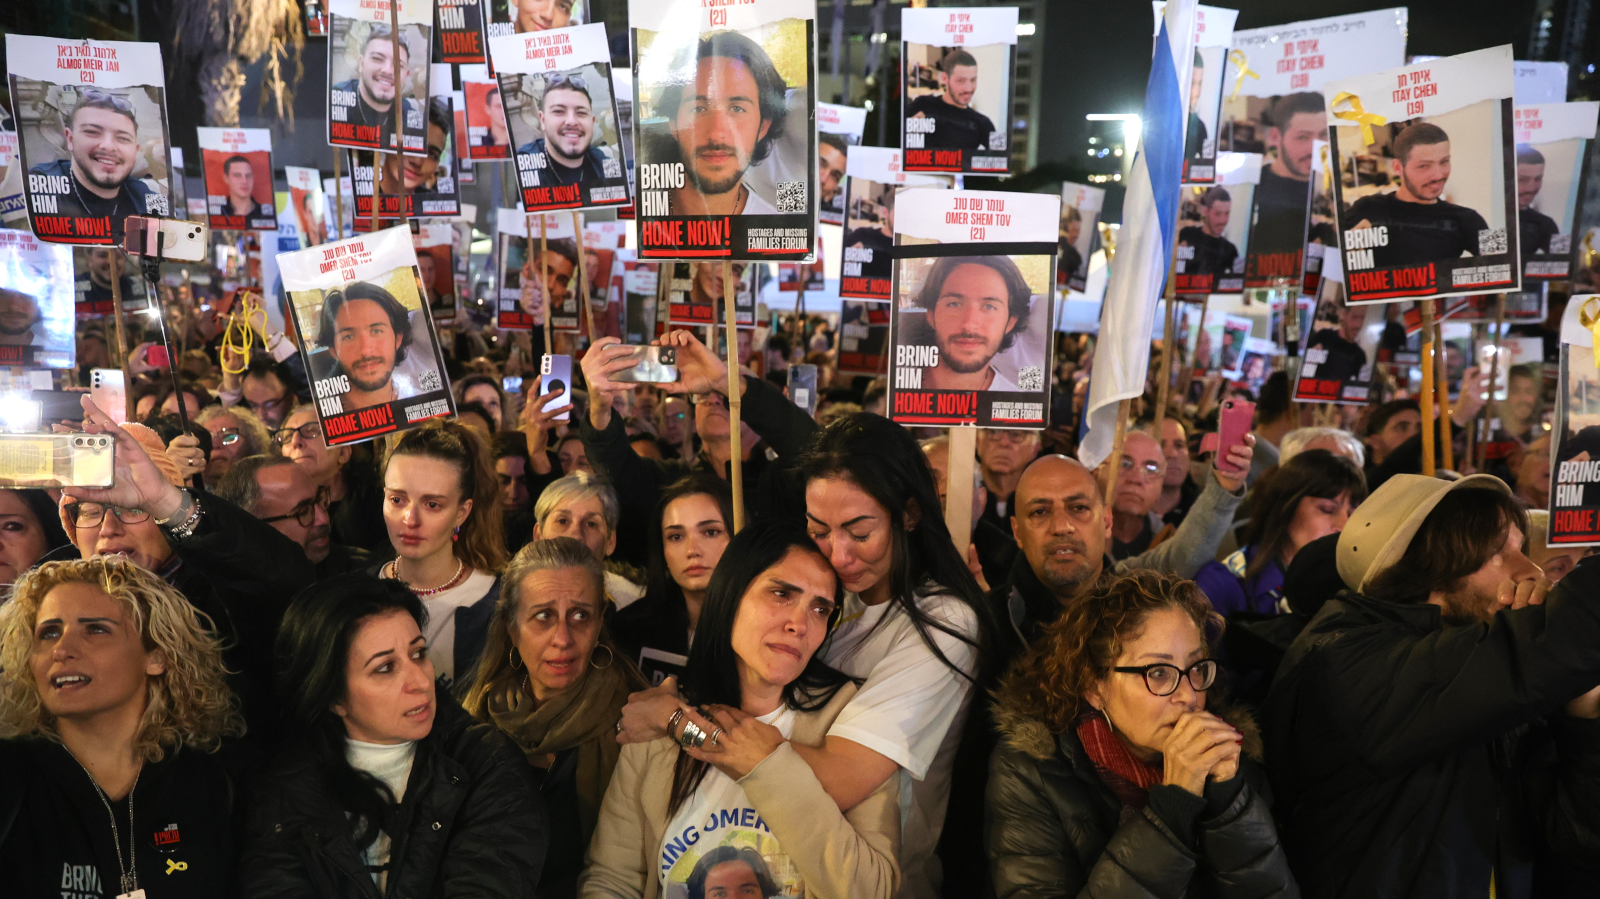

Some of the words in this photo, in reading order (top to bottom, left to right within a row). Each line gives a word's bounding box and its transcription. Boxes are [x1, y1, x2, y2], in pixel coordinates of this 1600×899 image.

[439, 9, 465, 29] HIM
[710, 9, 727, 26] (21)
[442, 32, 480, 54] HOME
[553, 33, 570, 44] אלמוג
[1297, 39, 1319, 54] איתי
[74, 46, 90, 58] מאיר
[93, 48, 117, 59] אלמוג
[526, 48, 545, 59] ALMOG
[546, 46, 560, 58] MEIR
[562, 44, 573, 56] JAN
[1284, 42, 1294, 58] חן
[57, 58, 82, 69] ALMOG
[84, 59, 103, 70] MEIR
[105, 60, 120, 72] JAN
[544, 58, 556, 69] (21)
[1277, 59, 1296, 74] ITAY
[1299, 54, 1324, 70] CHEN
[80, 71, 95, 83] (21)
[1398, 74, 1407, 89] חן
[1410, 69, 1431, 84] איתי
[331, 90, 356, 107] BRING
[1392, 88, 1411, 103] ITAY
[1414, 83, 1437, 99] CHEN
[331, 106, 347, 122] HIM
[1407, 100, 1424, 116] (19)
[331, 123, 355, 140] HOME
[356, 125, 381, 142] NOW!
[906, 118, 935, 133] BRING
[906, 133, 925, 149] HIM
[517, 152, 547, 171] BRING
[906, 150, 933, 165] HOME
[934, 149, 962, 166] NOW!
[520, 171, 541, 188] HIM
[641, 162, 684, 189] BRING
[28, 174, 70, 194] BRING
[355, 182, 374, 196] HIM
[524, 186, 551, 205] HOME
[552, 183, 580, 202] NOW!
[31, 194, 58, 214] HIM
[358, 197, 383, 211] HOE
[386, 196, 413, 210] NO!
[642, 191, 669, 216] HIM
[954, 198, 967, 210] טוב
[969, 198, 982, 211] שם
[986, 199, 1004, 212] עומר
[35, 216, 73, 236] HOME
[75, 216, 112, 237] NOW!
[946, 212, 968, 225] OMER
[971, 212, 993, 226] SHEM
[996, 213, 1011, 227] TOV
[642, 221, 683, 246] HOME
[687, 217, 731, 246] NOW!
[748, 229, 773, 237] HOSTAGES
[774, 229, 784, 237] AND
[785, 228, 807, 237] MISSING
[970, 228, 985, 241] (21)
[1344, 226, 1388, 250] BRING
[334, 246, 346, 257] שם
[347, 242, 364, 253] עומר
[748, 238, 780, 250] FAMILIES
[782, 238, 808, 250] FORUM
[322, 248, 334, 261] טוב
[844, 248, 873, 263] BRING
[1347, 249, 1374, 271] HIM
[320, 260, 338, 274] OMER
[339, 256, 358, 270] SHEM
[844, 262, 862, 277] HIM
[342, 269, 355, 281] (21)
[1350, 270, 1389, 292] HOME
[1393, 262, 1435, 288] NOW!
[1452, 274, 1484, 285] FAMILIES
[1485, 270, 1511, 283] FORUM
[842, 278, 868, 292] HOME
[0, 346, 23, 360] OW!
[896, 345, 938, 368] BRING
[314, 374, 350, 398] BRING
[895, 368, 922, 389] HIM
[319, 397, 343, 418] HIM
[894, 392, 933, 414] HOME
[937, 392, 977, 415] NOW!
[325, 414, 359, 437] HOME
[360, 403, 394, 430] NOW!
[406, 408, 430, 421] FAMILIES
[430, 404, 450, 416] FORUM
[992, 409, 1020, 420] FAMILIES
[1021, 410, 1043, 420] FORUM
[1557, 461, 1600, 483] BRING
[1556, 484, 1584, 507] HIM
[1554, 510, 1594, 532] HOME
